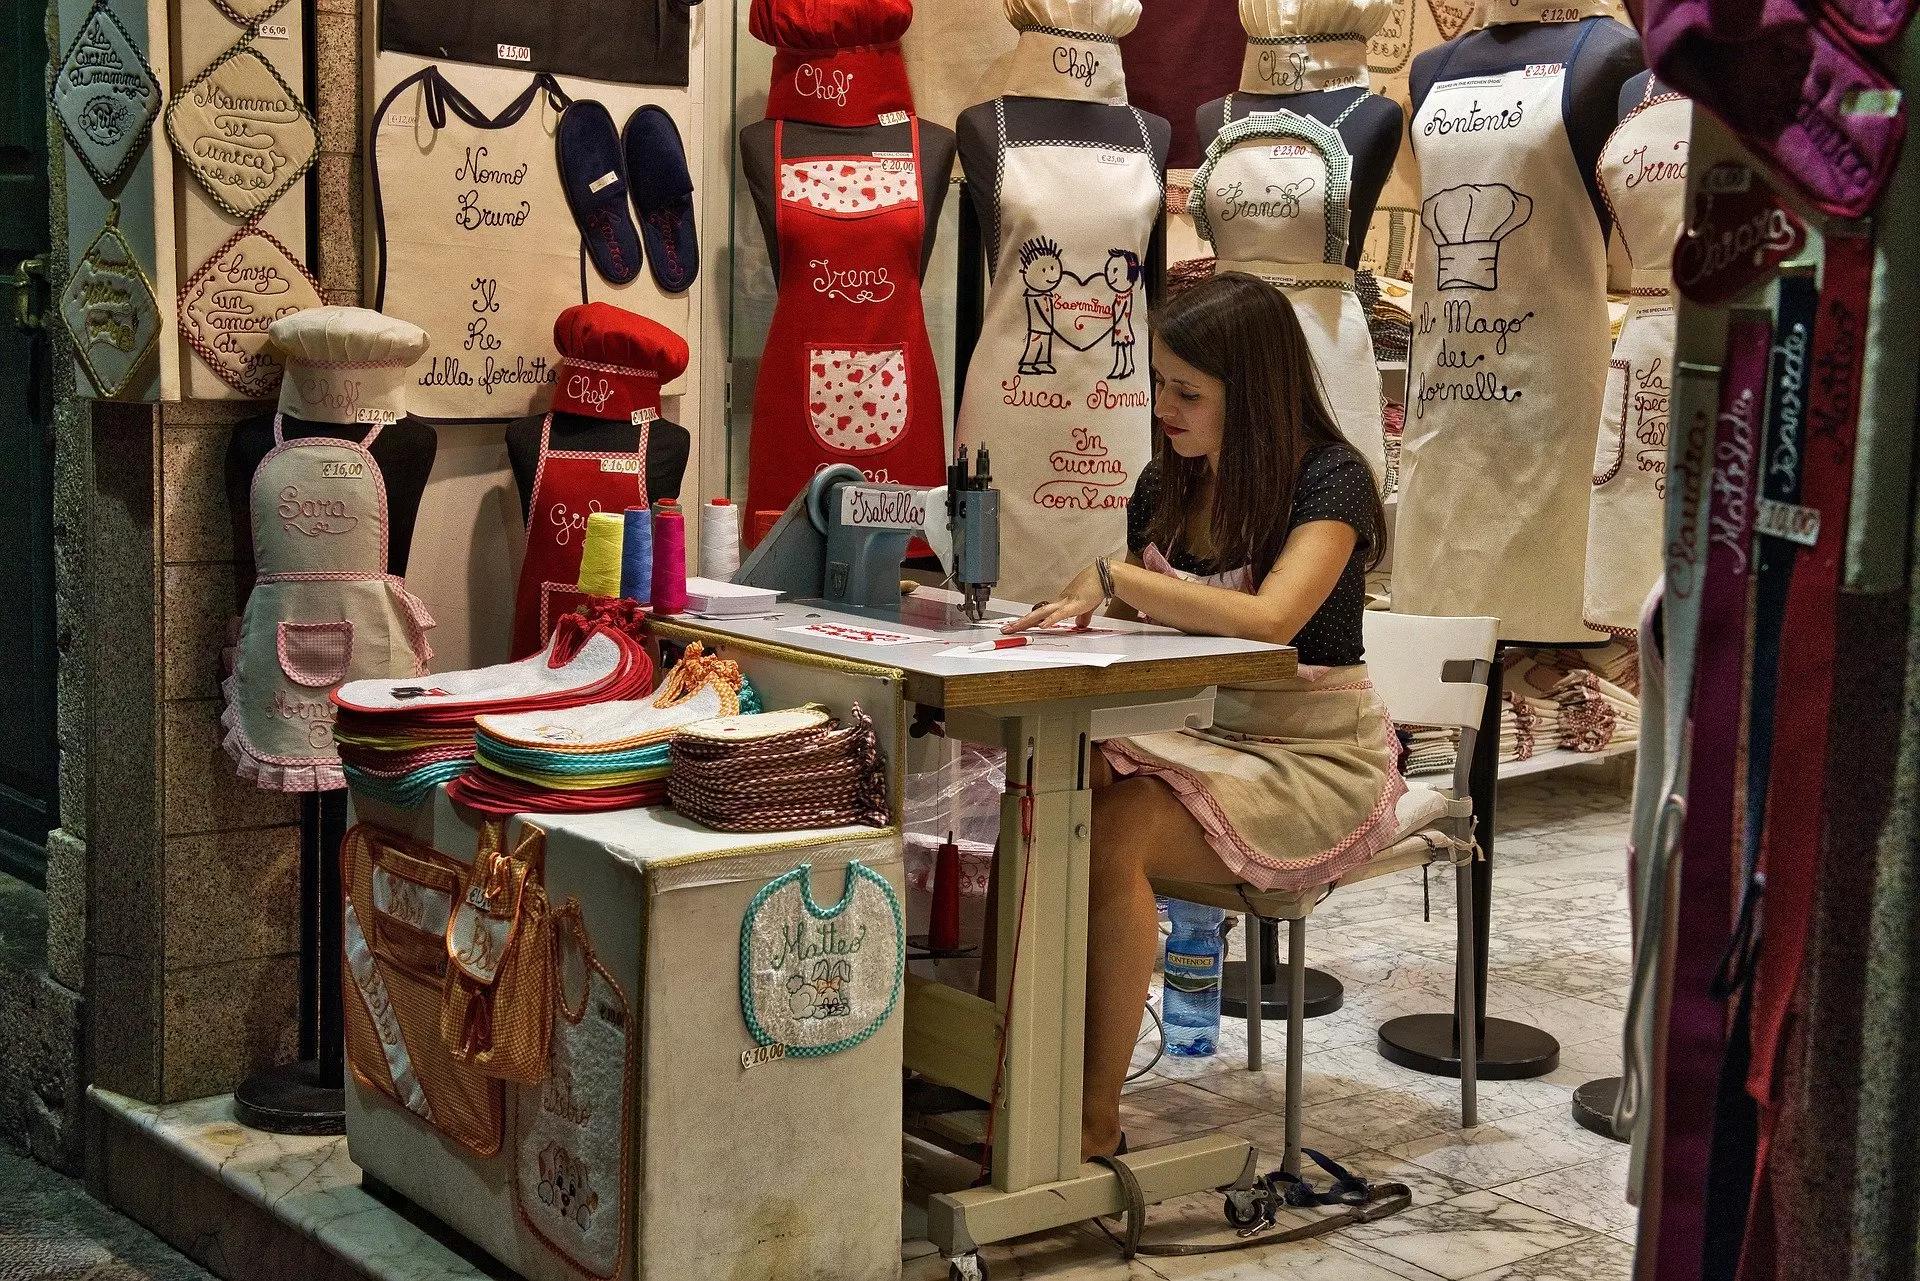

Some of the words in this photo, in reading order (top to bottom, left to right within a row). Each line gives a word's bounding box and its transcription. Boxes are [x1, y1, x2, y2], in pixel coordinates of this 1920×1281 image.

[795, 63, 854, 107] Chef
[1053, 46, 1100, 88] Chef
[1258, 50, 1310, 92] Chef
[194, 84, 296, 112] Mamma
[1423, 100, 1524, 136] Antonio
[455, 146, 528, 185] Nonno
[455, 189, 531, 231] Bruno
[1216, 181, 1301, 221] Franca
[218, 253, 282, 293] Enzo
[809, 259, 896, 293] Irene
[471, 277, 500, 313] Il
[1053, 292, 1113, 316] Taormina
[463, 317, 502, 351] Re
[1443, 299, 1535, 356] Mago
[1436, 337, 1485, 368] dei
[418, 356, 474, 387] della
[477, 355, 560, 394] forchetta
[567, 374, 615, 413] Chef
[1001, 374, 1072, 410] Luca
[1086, 379, 1150, 410] Anna
[301, 378, 362, 417] Chef
[1416, 371, 1523, 420] fornelli
[1071, 427, 1106, 451] In
[1052, 456, 1126, 475] cucina
[278, 484, 348, 519] Sara
[850, 490, 926, 526] Isabella
[771, 920, 868, 971] Matteo
